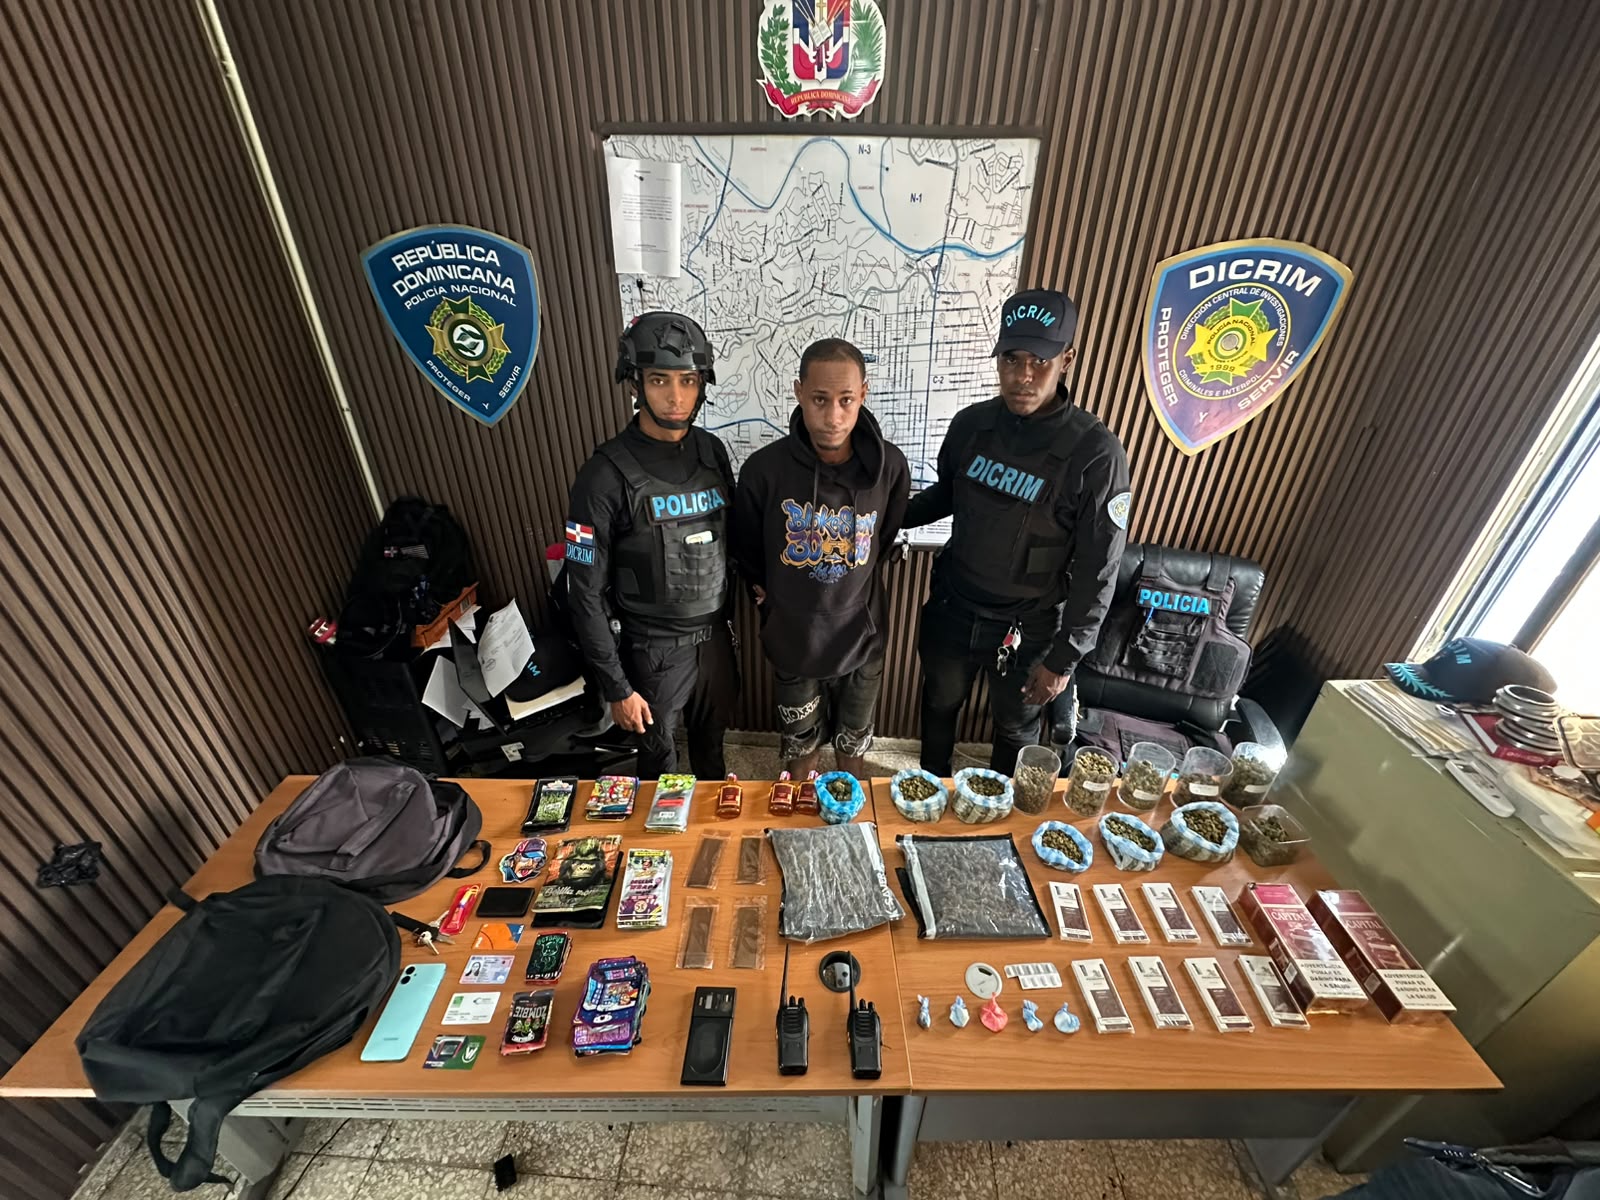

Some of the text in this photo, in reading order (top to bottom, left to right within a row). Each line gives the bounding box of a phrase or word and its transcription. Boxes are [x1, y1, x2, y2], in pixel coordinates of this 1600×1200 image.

[858, 144, 872, 154] N-3
[910, 193, 923, 203] N-1
[391, 240, 501, 272] REPÚBLICA
[392, 264, 516, 297] DOMINICANA
[621, 284, 632, 294] C-3
[1189, 258, 1322, 297] DICRIM
[404, 284, 517, 310] POLICÍA NACIONAL
[1005, 304, 1056, 328] DICRIM
[1212, 287, 1248, 304] CENTRAL
[1250, 287, 1260, 296] DE
[1260, 290, 1287, 347] INVESTIGACIONES
[1232, 319, 1256, 346] NACIONAL
[1157, 307, 1300, 423] PROTEGER Y SERVIR
[426, 359, 522, 410] PROTEGER Y SERVIR
[932, 375, 945, 384] C-2
[1178, 369, 1214, 397] CRIMINALES
[1222, 373, 1261, 396] INTERPOL
[966, 454, 1045, 502] DICRIM
[652, 488, 725, 518] POLICIA
[566, 543, 593, 563] DICRIM
[1139, 588, 1210, 615] POLICIA
